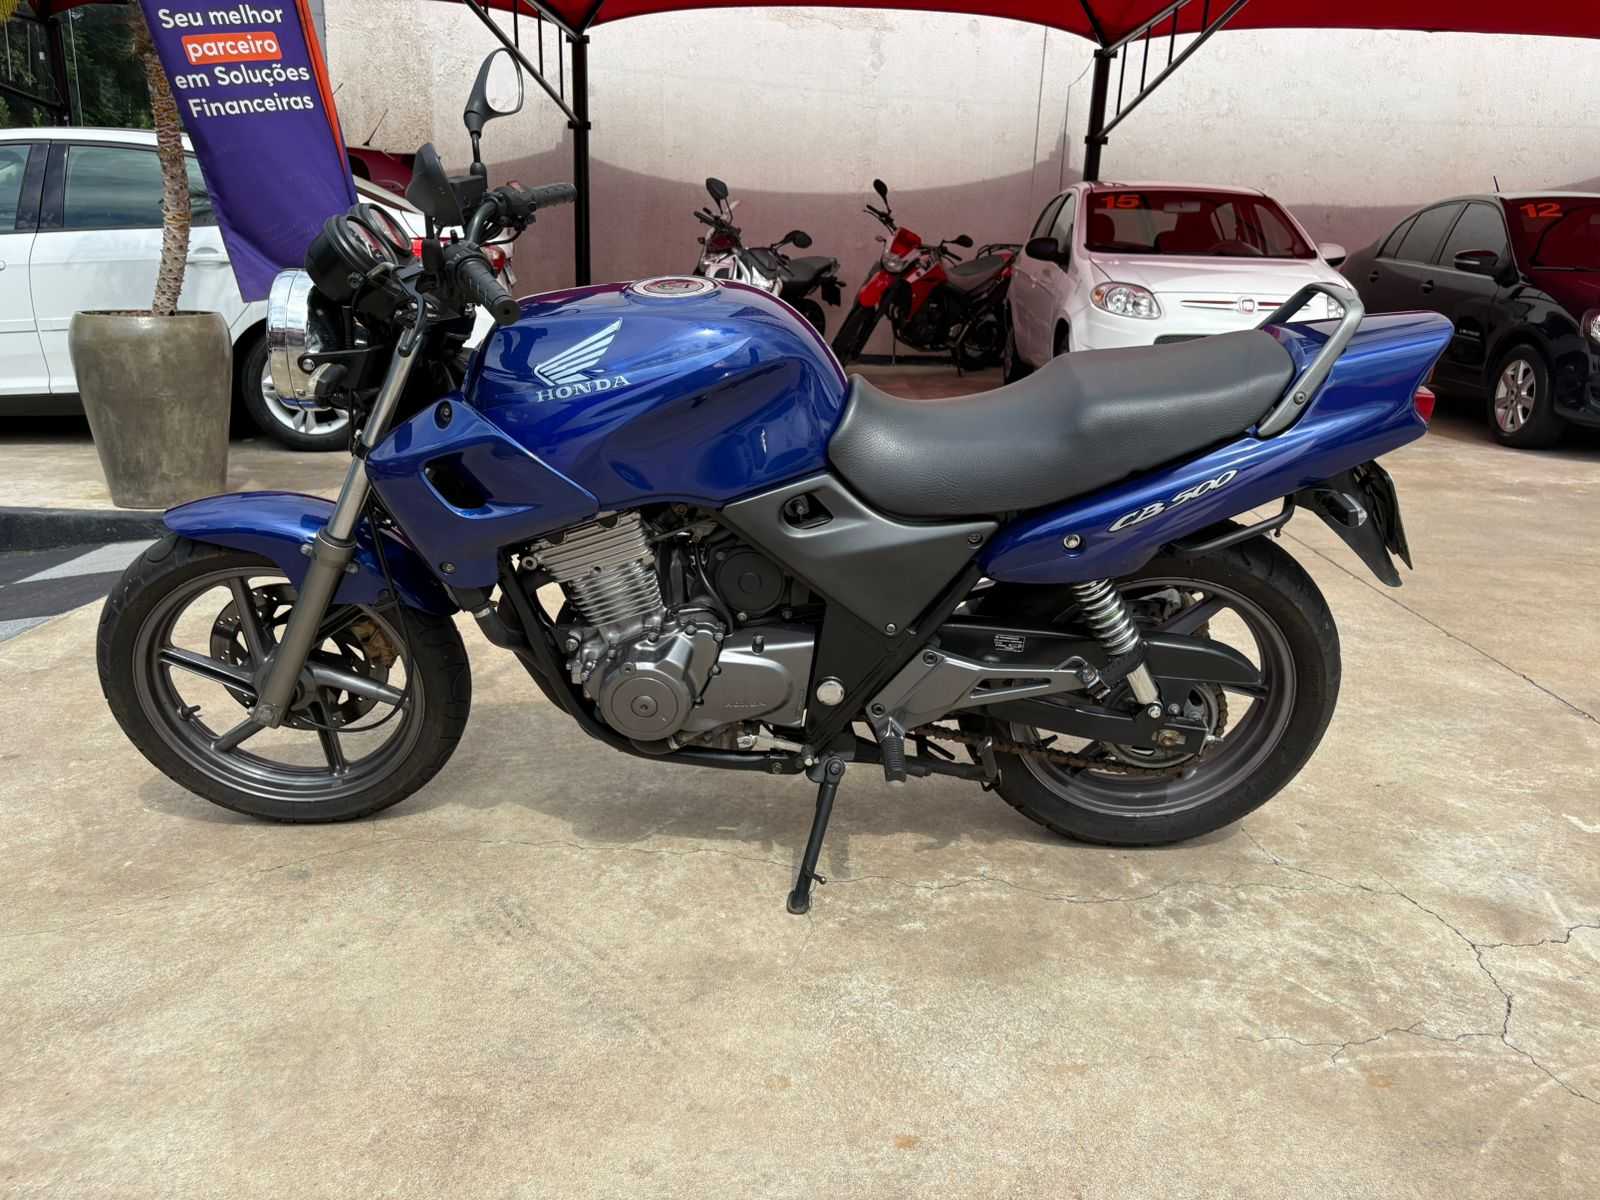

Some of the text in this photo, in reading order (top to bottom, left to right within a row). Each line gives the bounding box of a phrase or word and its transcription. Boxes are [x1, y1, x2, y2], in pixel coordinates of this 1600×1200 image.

[158, 4, 284, 29] Seu melhor
[186, 35, 278, 62] parceiro
[175, 64, 311, 89] em Soluções
[188, 92, 314, 119] Financeiras
[1101, 194, 1141, 209] 15
[1520, 202, 1564, 218] 12
[535, 375, 632, 402] HONDA
[1107, 469, 1239, 533] CB 500
